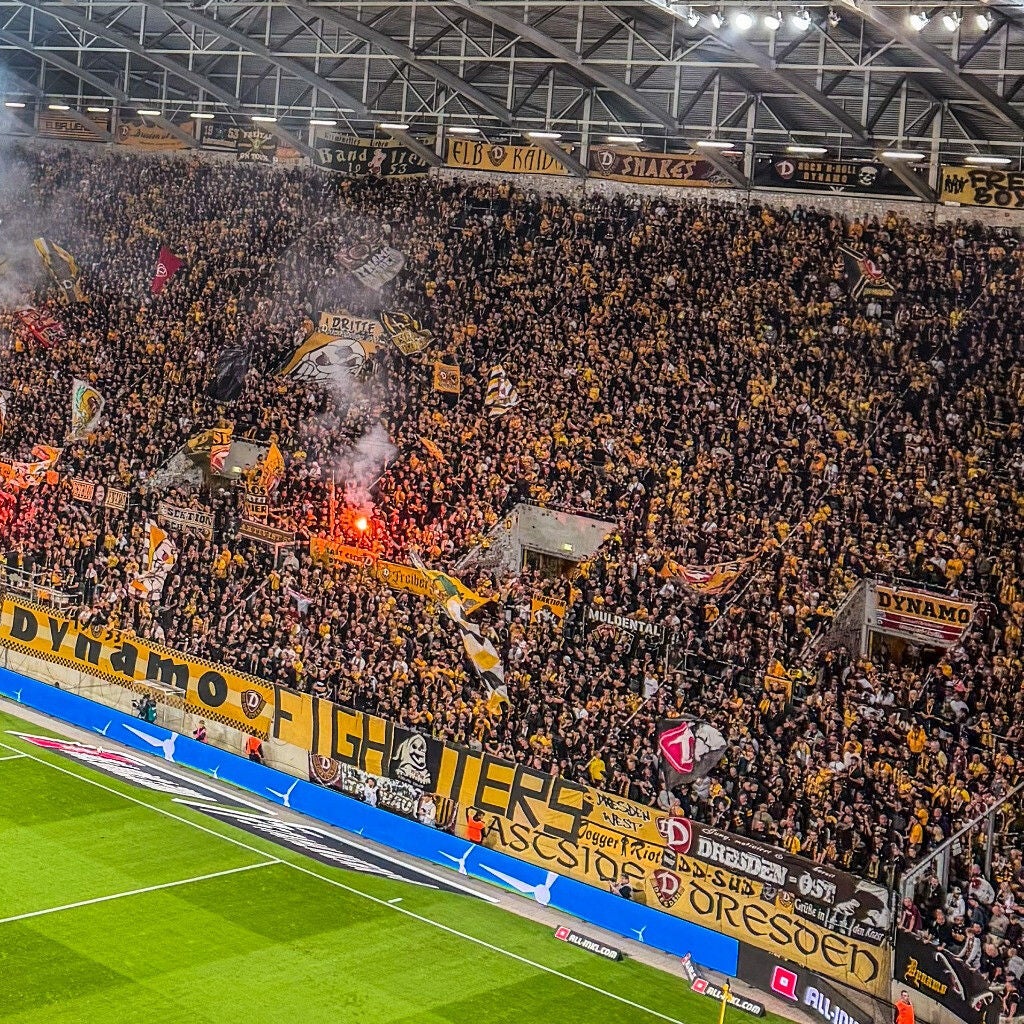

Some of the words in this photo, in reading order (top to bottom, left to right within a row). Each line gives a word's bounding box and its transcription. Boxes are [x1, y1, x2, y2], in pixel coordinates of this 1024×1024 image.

[588, 607, 662, 636] MULDENTAL
[877, 591, 971, 624] DYNAMO
[630, 840, 662, 864] Riot
[697, 834, 789, 887] DRESDEN
[794, 898, 817, 917] Grüße
